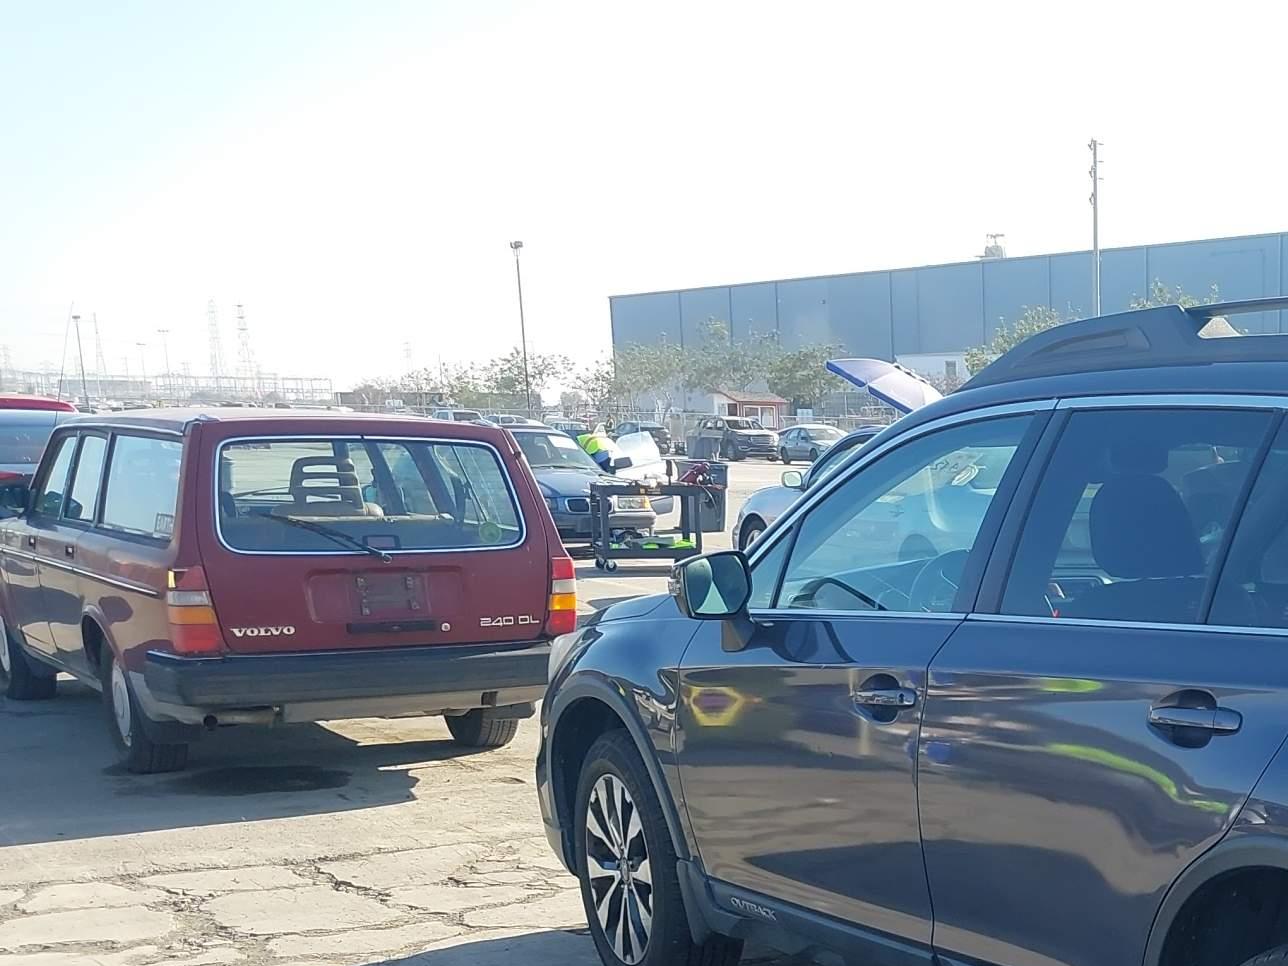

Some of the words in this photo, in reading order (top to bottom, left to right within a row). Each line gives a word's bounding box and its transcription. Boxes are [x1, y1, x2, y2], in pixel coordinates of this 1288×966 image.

[479, 616, 514, 627] 240
[518, 614, 540, 625] DL
[229, 625, 296, 638] VOLVO
